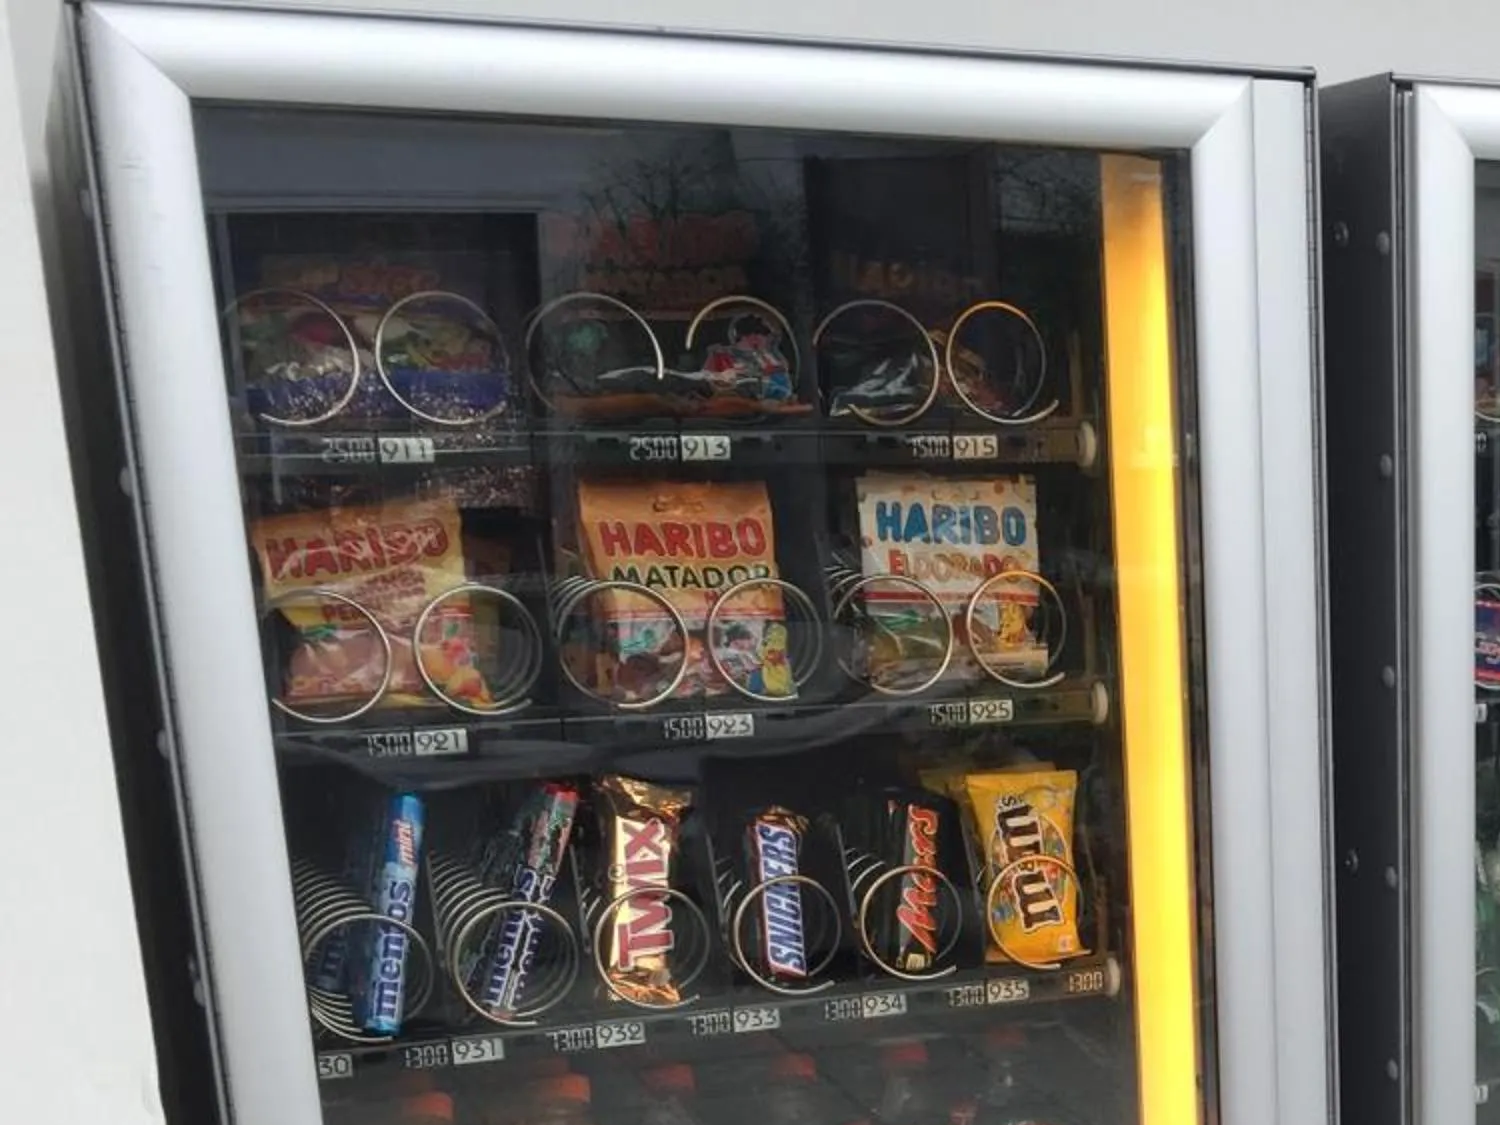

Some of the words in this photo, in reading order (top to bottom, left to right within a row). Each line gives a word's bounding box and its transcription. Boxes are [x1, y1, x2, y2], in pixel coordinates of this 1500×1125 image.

[380, 439, 433, 462] 911
[681, 437, 731, 460] 913
[954, 437, 998, 458] 915
[876, 501, 1027, 546] HARIBO
[264, 517, 449, 580] HARIBO
[600, 517, 768, 558] HARIBO
[970, 702, 1013, 722] 925
[707, 717, 753, 739] 923
[417, 731, 465, 754] 921
[896, 803, 939, 954] Mars
[616, 817, 676, 974] TWIX
[757, 824, 808, 976] SNICKERS
[987, 982, 1029, 1003] 935
[864, 996, 906, 1018] 934
[735, 1009, 779, 1031] 933
[599, 1024, 642, 1047] 932
[455, 1040, 500, 1064] 931
